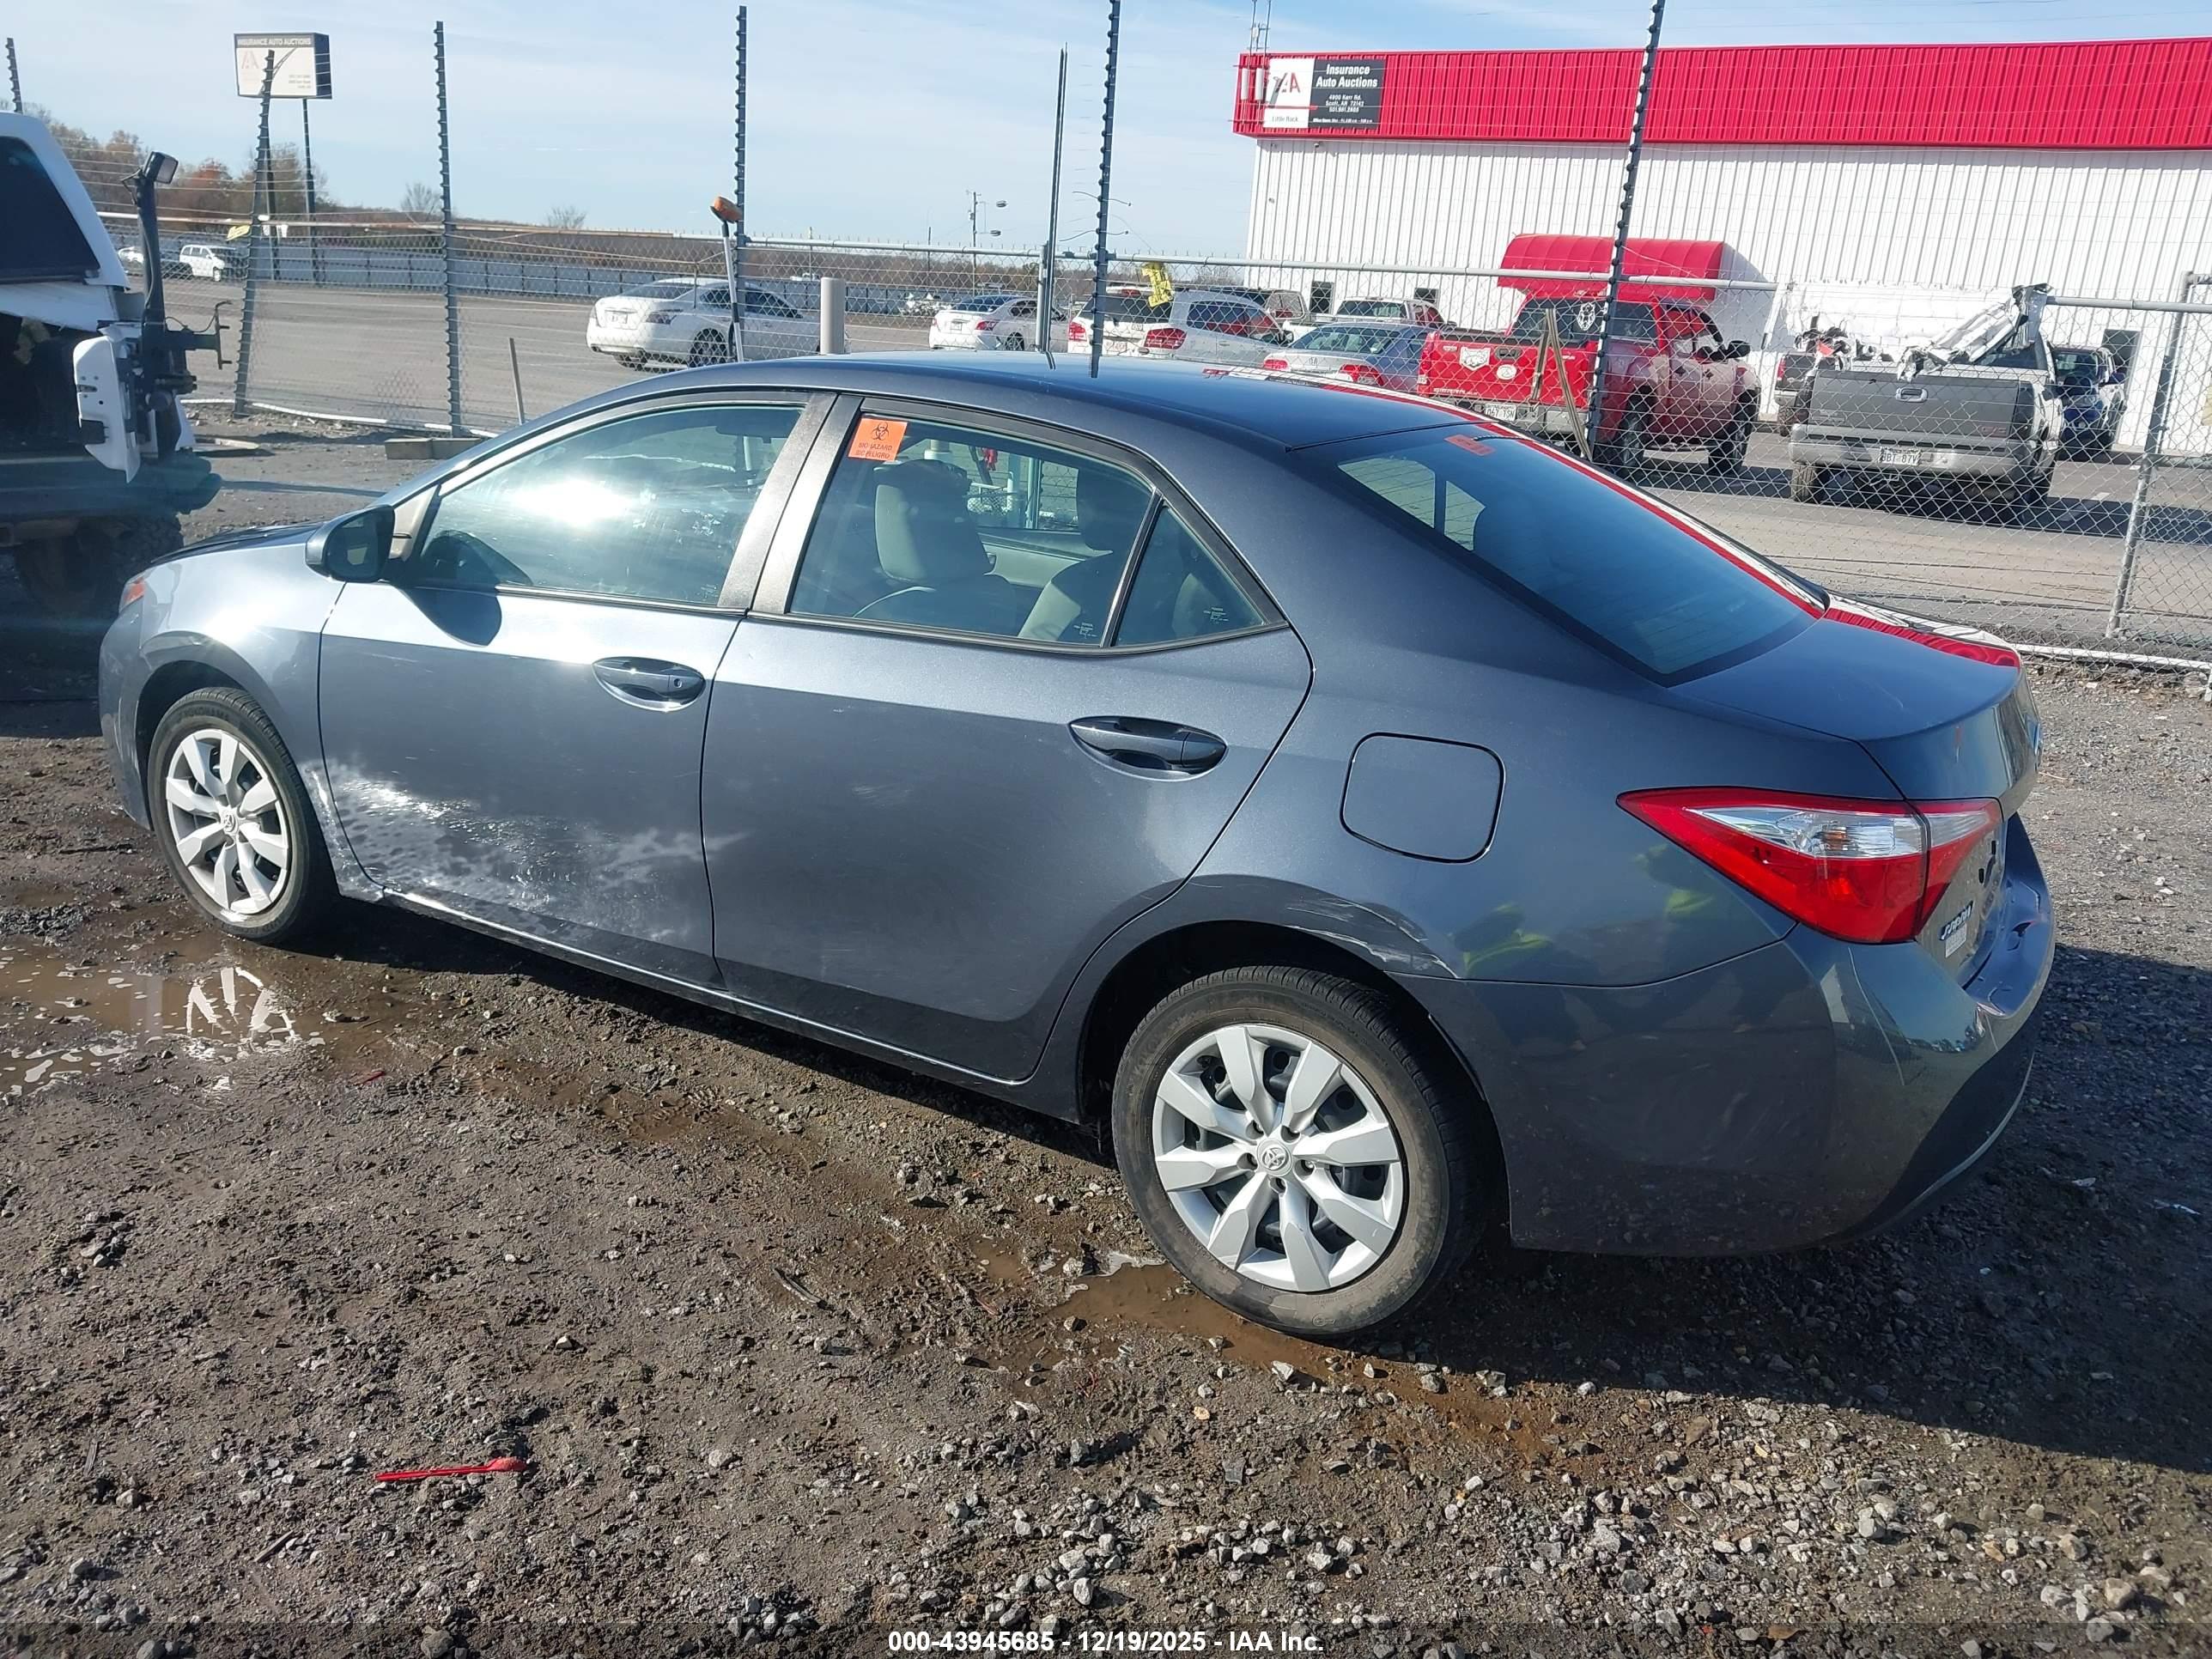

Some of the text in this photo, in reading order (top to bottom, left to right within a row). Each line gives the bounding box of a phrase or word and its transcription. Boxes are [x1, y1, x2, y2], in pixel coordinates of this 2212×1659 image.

[1326, 64, 1370, 75] Insurance
[1316, 76, 1378, 88] Auto Auctions
